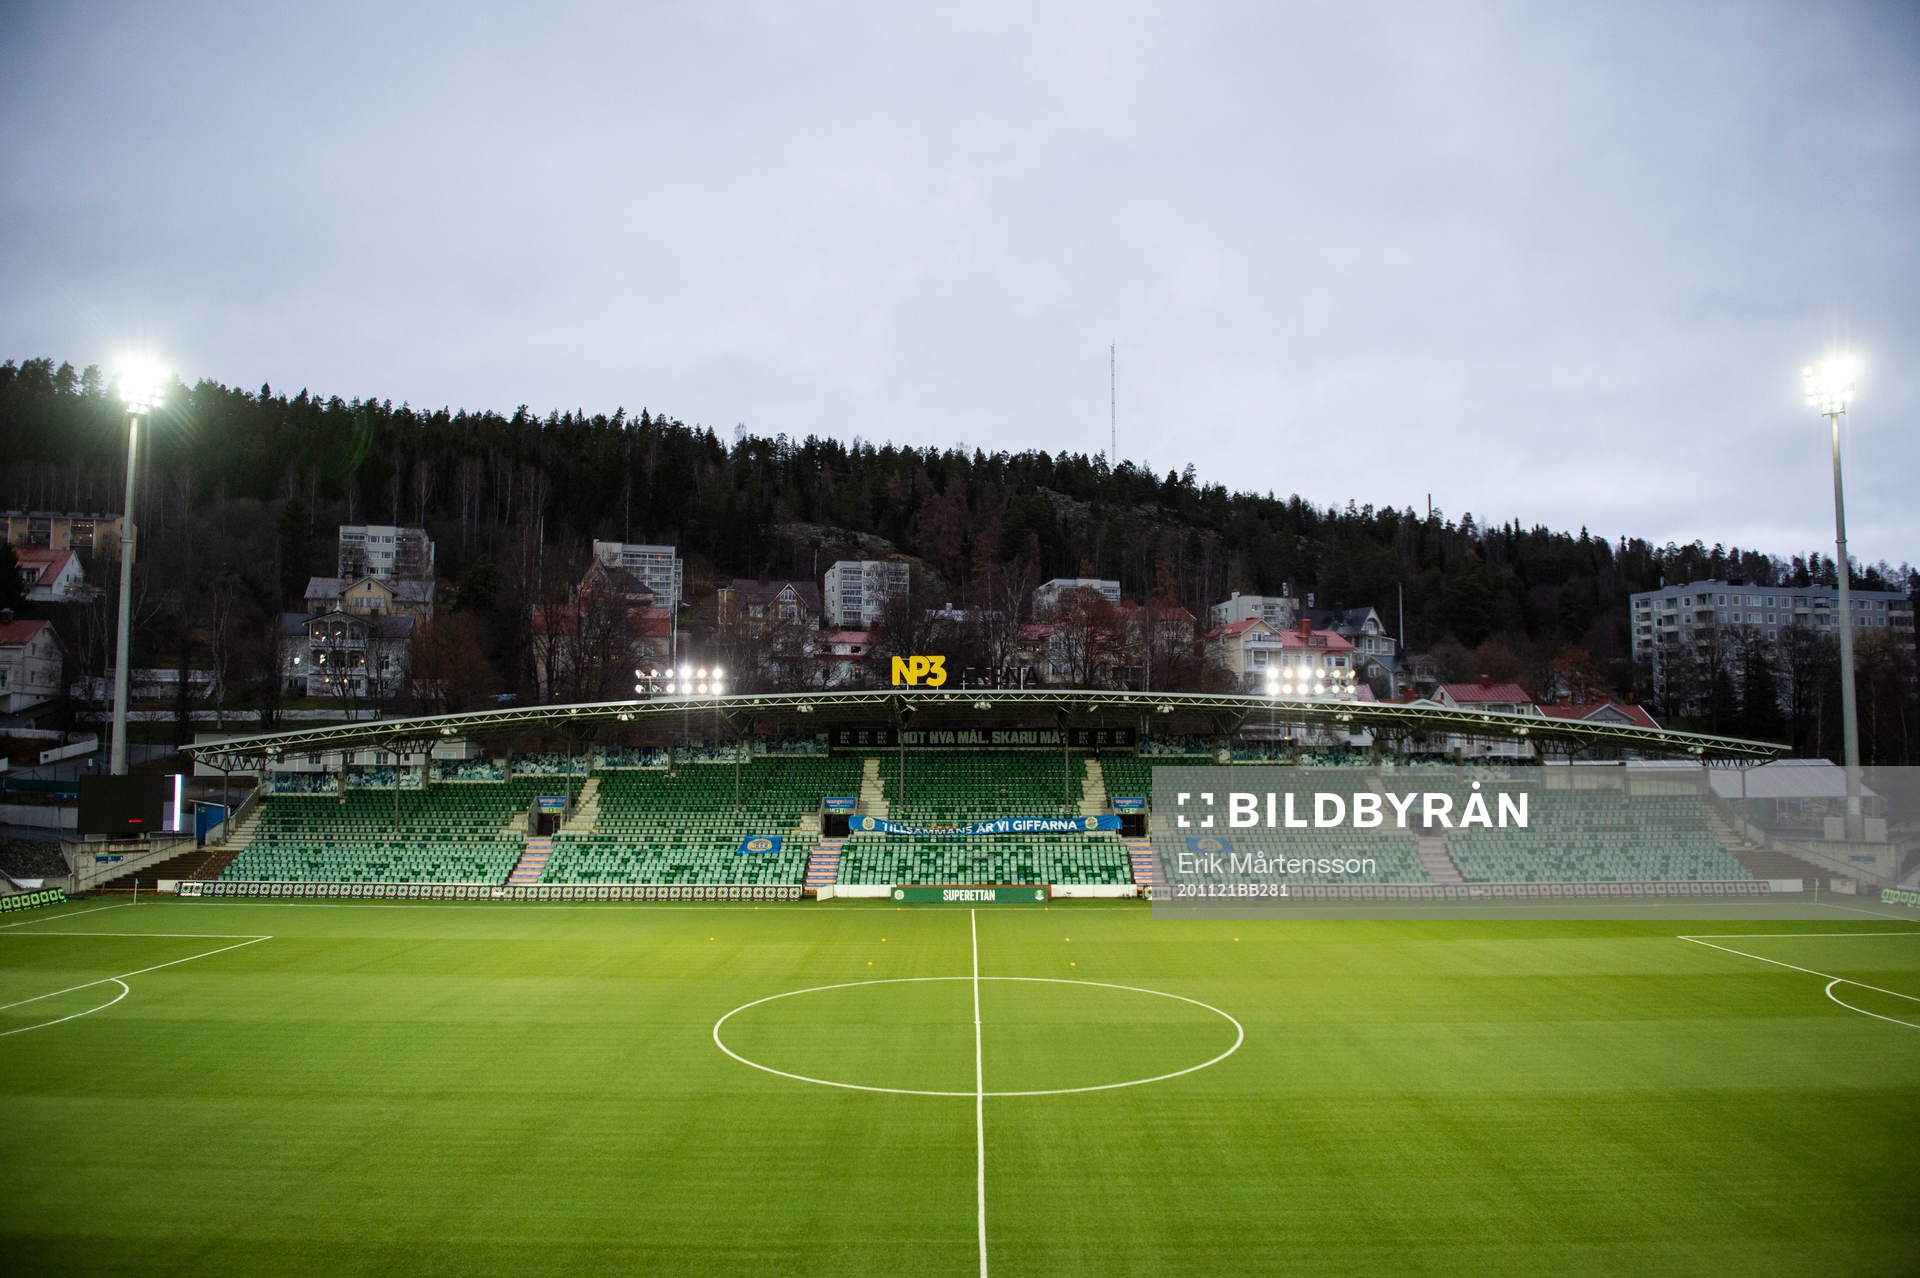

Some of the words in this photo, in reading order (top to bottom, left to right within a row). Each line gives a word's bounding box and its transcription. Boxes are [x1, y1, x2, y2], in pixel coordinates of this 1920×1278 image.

[892, 655, 947, 687] NP3
[930, 731, 955, 744] NYA
[882, 821, 973, 835] TILLSAMMANS
[996, 820, 1009, 832] VI
[1012, 820, 1078, 831] GIFFARNA
[943, 889, 996, 901] SUPERETTAN
